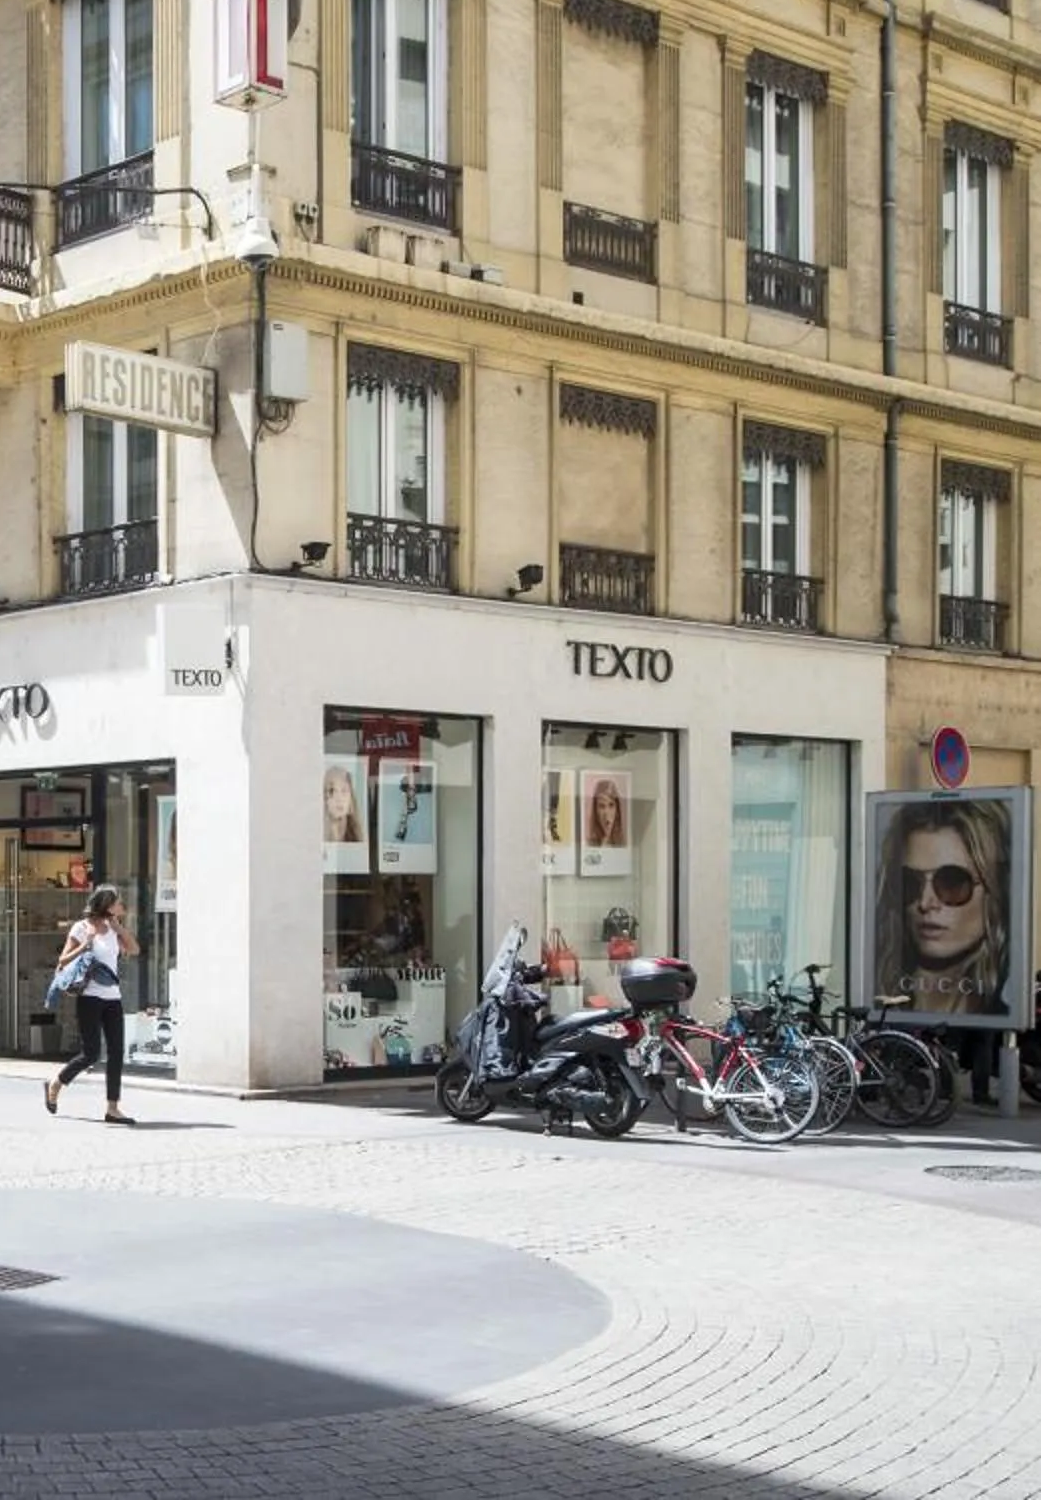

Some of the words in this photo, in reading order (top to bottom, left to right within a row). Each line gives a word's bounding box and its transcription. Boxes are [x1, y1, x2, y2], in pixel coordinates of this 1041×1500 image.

[81, 349, 216, 426] RESIDENCE
[567, 641, 674, 682] TEXTO
[171, 669, 223, 687] TEXTO
[900, 976, 984, 997] GUCCI
